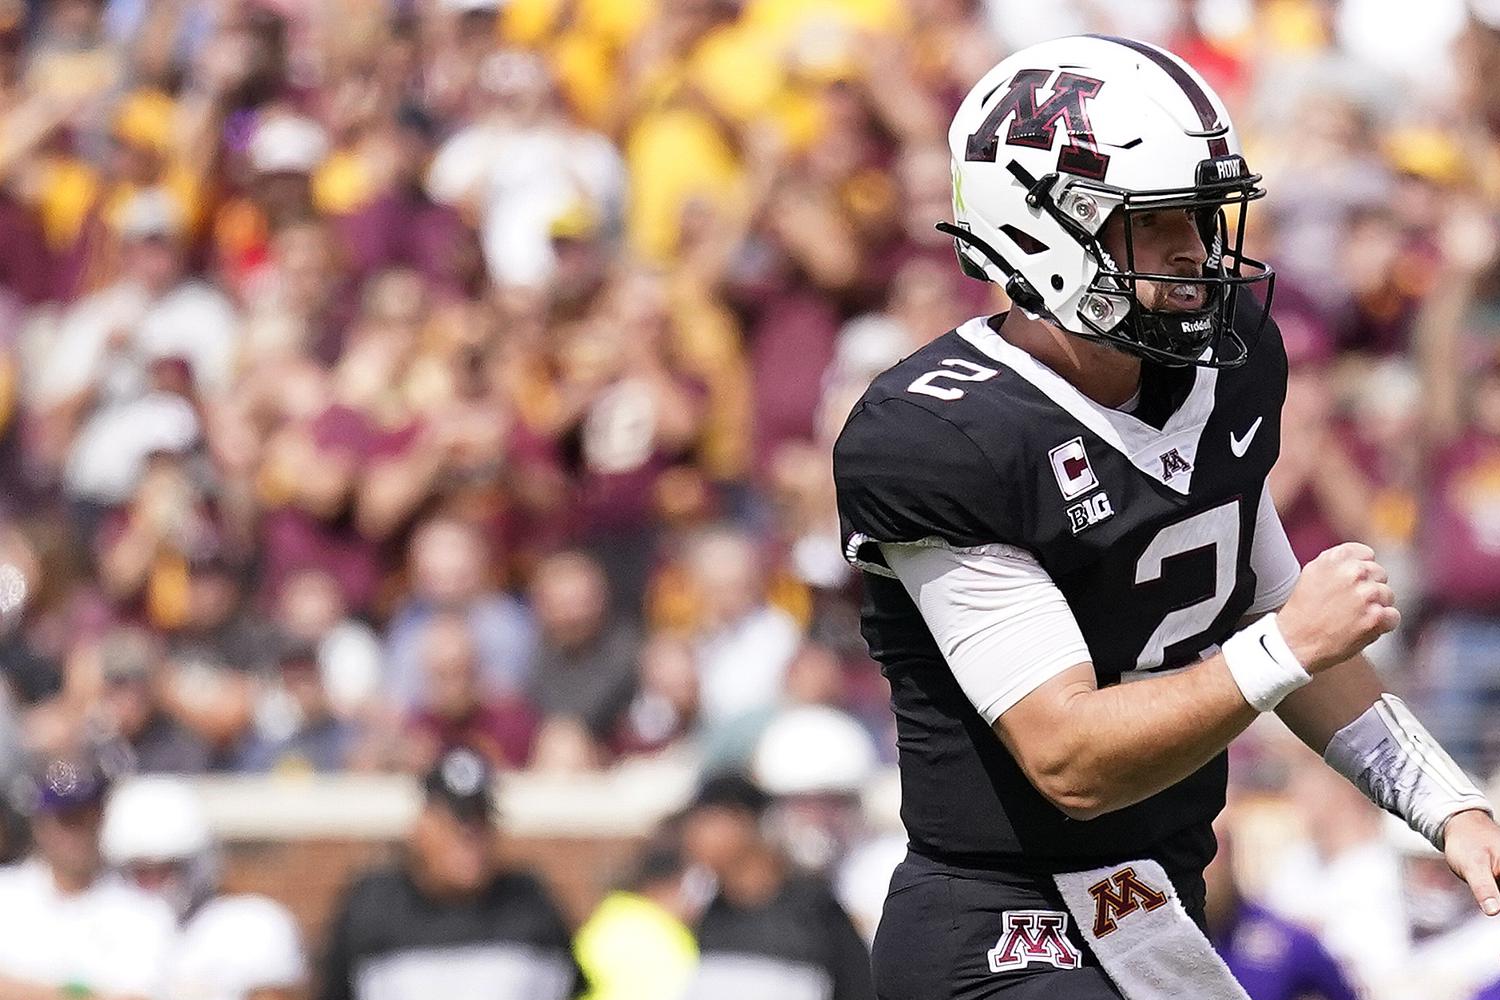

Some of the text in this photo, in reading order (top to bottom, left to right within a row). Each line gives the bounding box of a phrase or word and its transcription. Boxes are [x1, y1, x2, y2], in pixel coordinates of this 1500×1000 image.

[965, 69, 1110, 184] M
[1206, 234, 1222, 270] Ridd
[905, 358, 1000, 402] 2
[1053, 441, 1094, 497] C
[1158, 447, 1193, 483] M
[1120, 497, 1241, 687] 2
[1088, 866, 1168, 940] M
[988, 910, 1082, 972] M
